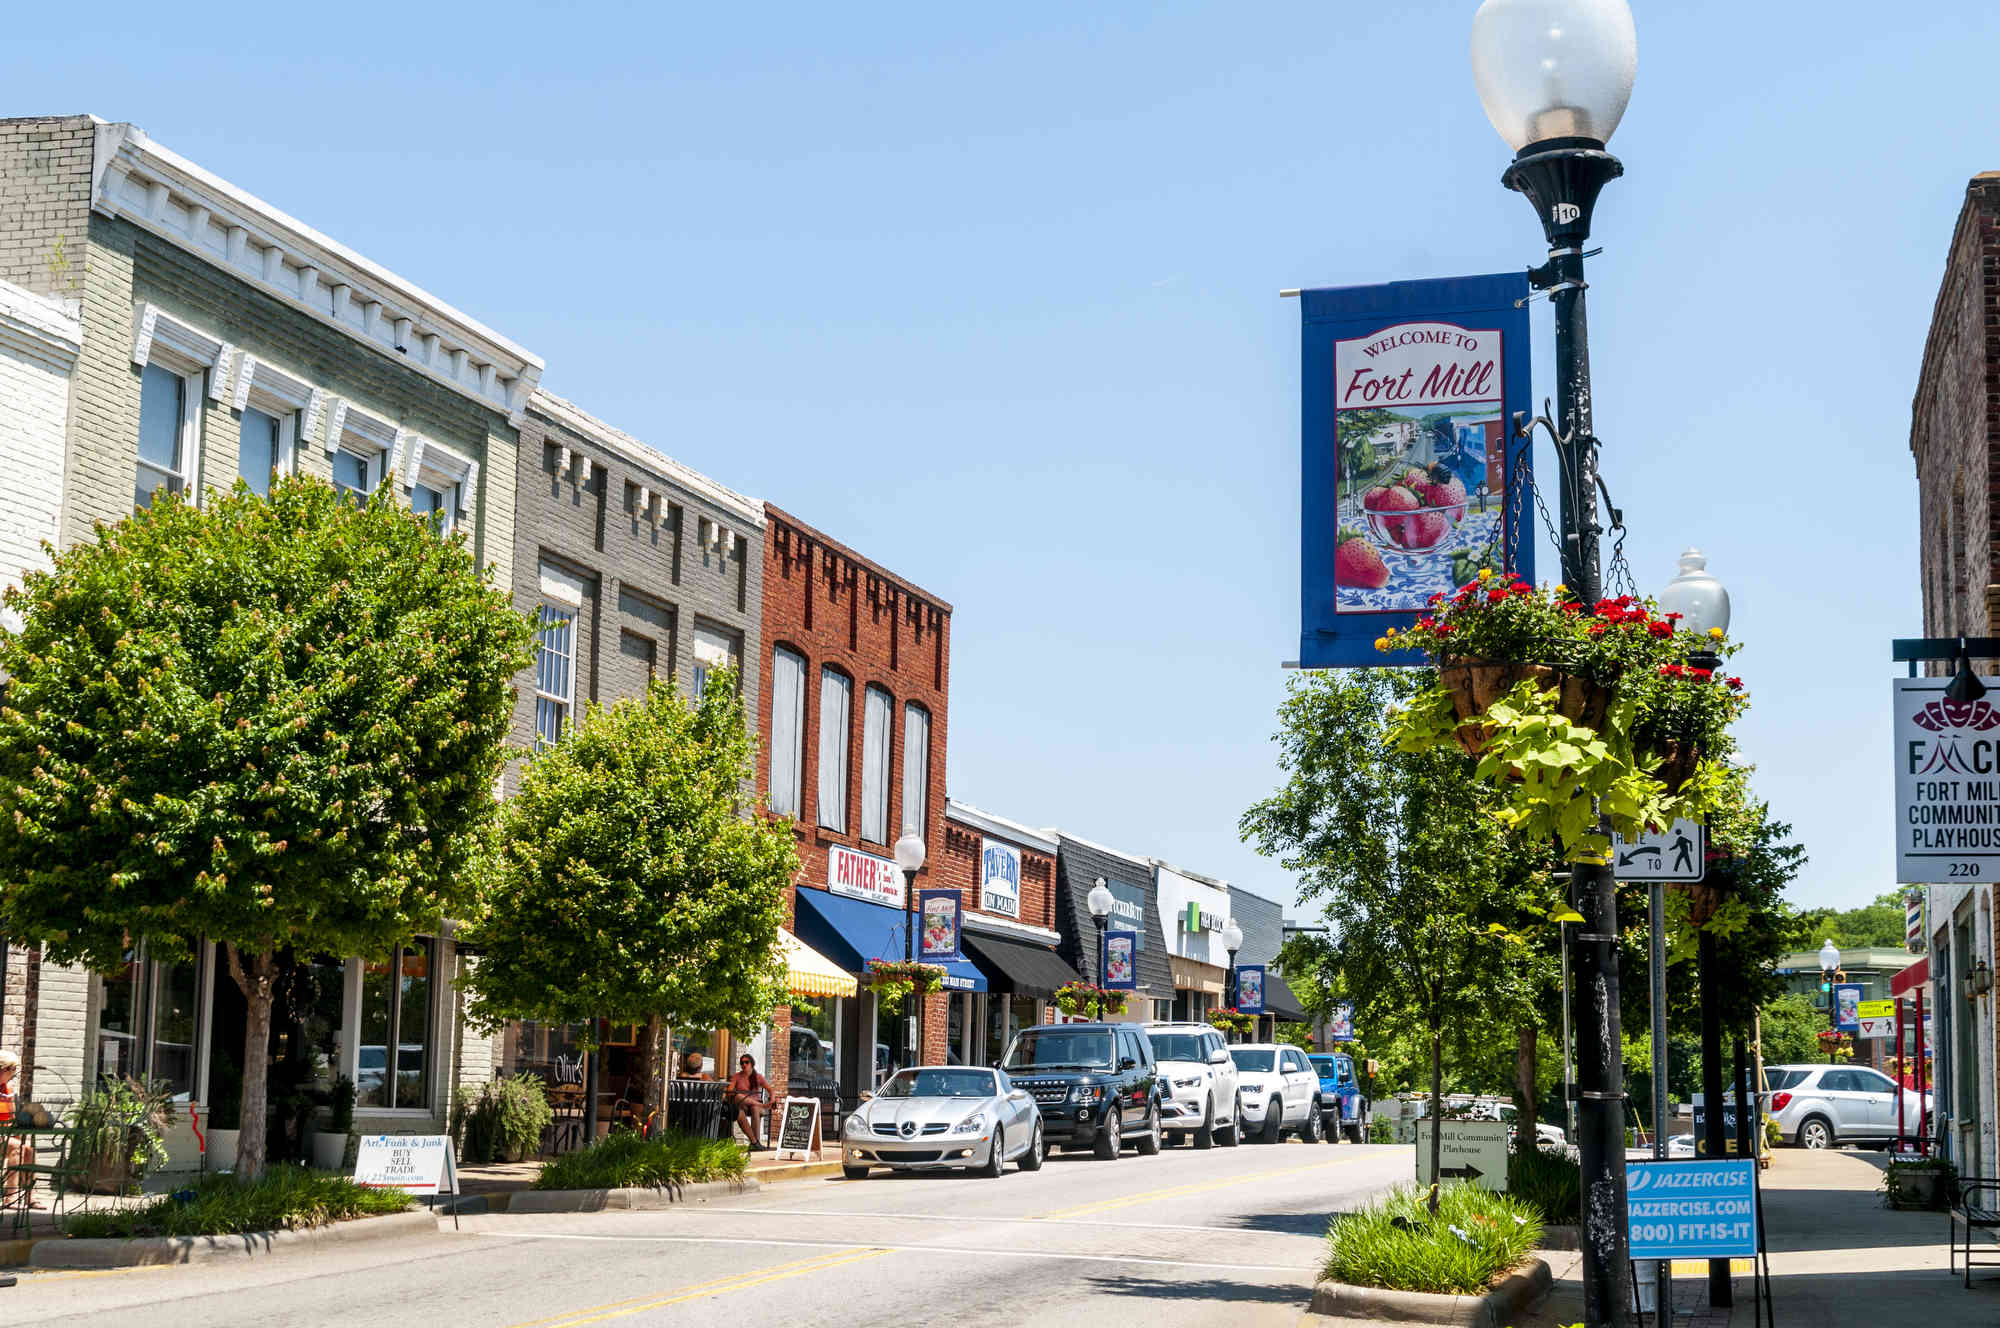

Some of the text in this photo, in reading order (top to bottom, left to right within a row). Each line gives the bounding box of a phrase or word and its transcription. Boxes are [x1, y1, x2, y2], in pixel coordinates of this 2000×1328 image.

[1561, 207, 1578, 219] 10
[1363, 331, 1478, 359] WELCOME TO
[1344, 359, 1495, 403] Fort Mill
[1916, 781, 2000, 801] FORT MIL
[984, 848, 1019, 895] TAVERN
[1648, 858, 1662, 871] TO
[1949, 863, 1980, 877] 220
[985, 893, 995, 907] ON
[385, 1138, 408, 1148] Funk
[411, 1138, 419, 1148] &
[421, 1138, 442, 1149] Junk
[1440, 1131, 1455, 1141] Mill
[1457, 1132, 1504, 1143] Community
[1443, 1144, 1480, 1154] Playhouse
[391, 1158, 411, 1166] SELL
[385, 1166, 416, 1174] TRADE
[1652, 1171, 1748, 1189] JAZZERCISE
[1678, 1222, 1751, 1240] FIT-IS-IT
